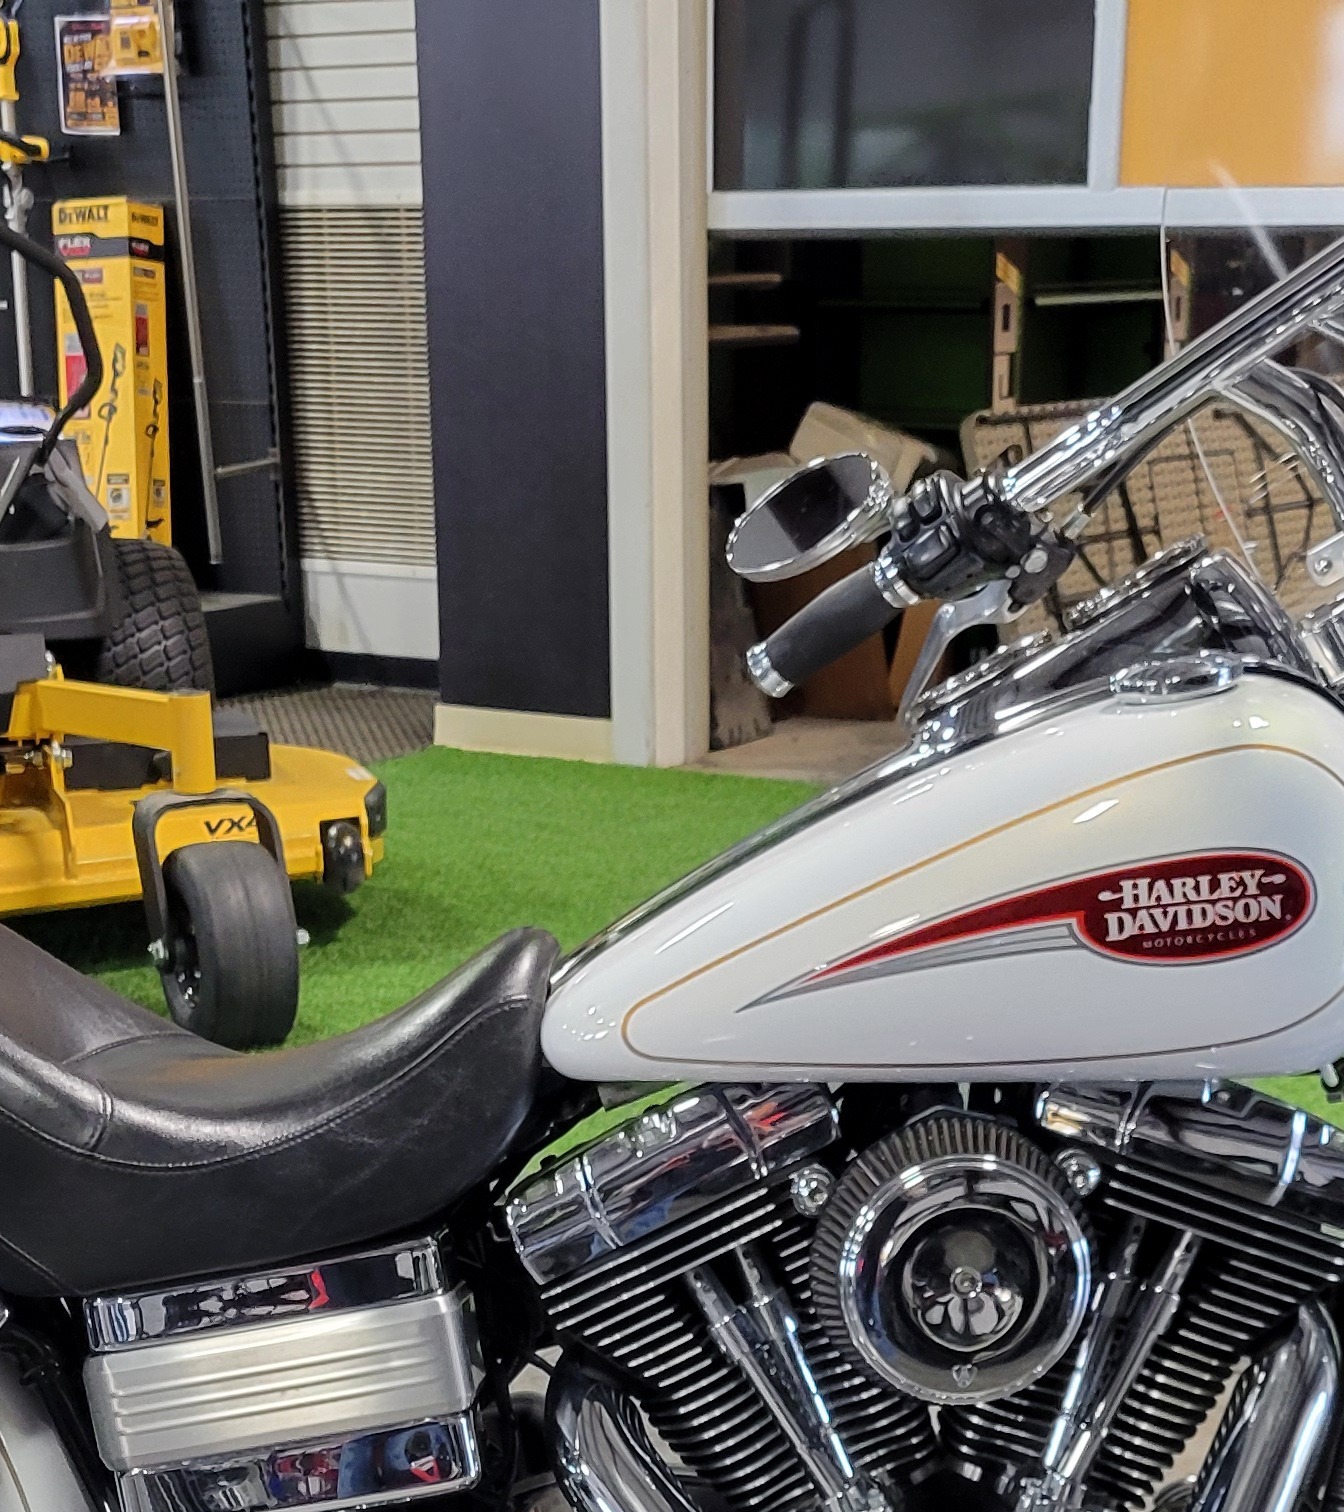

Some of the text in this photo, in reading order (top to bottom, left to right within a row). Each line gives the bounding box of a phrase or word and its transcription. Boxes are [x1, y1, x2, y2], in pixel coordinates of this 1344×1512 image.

[1118, 868, 1266, 909] HARLEY
[1104, 893, 1285, 942] DAVIDSON
[1142, 928, 1258, 949] MOTORCYCLES
